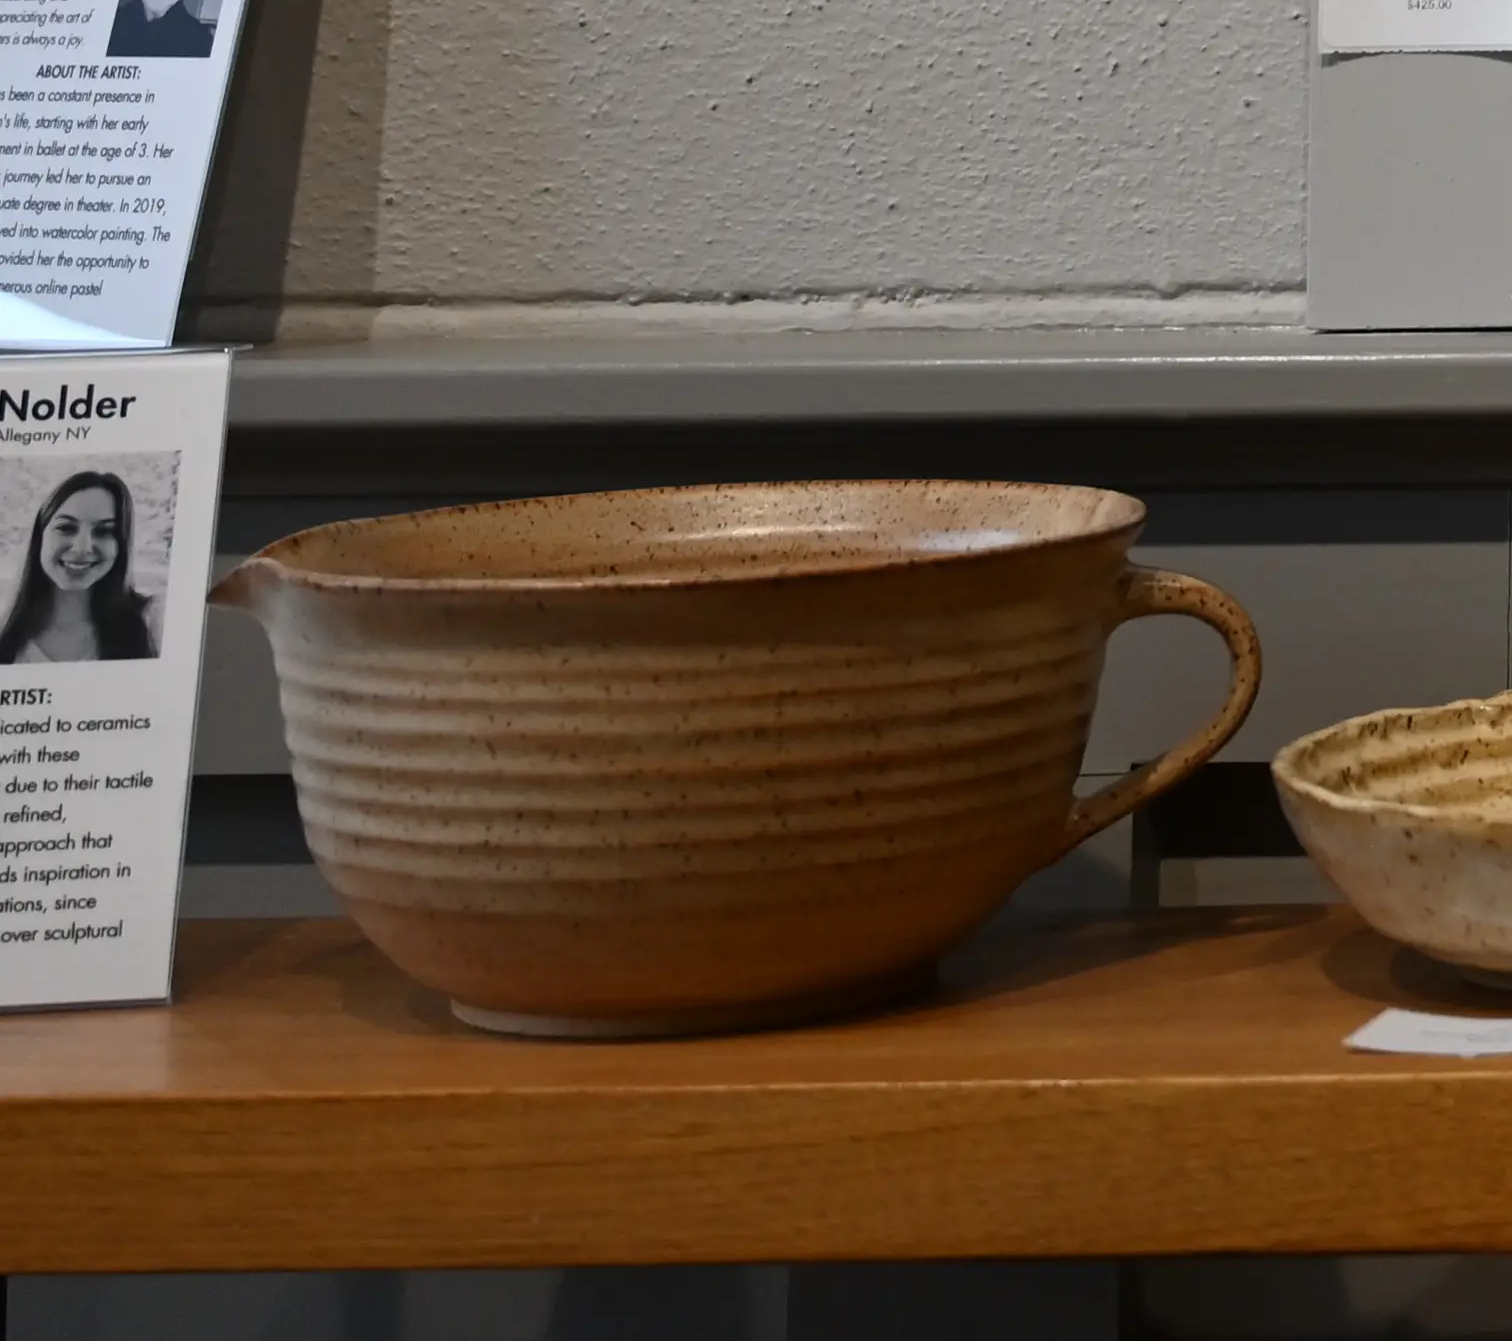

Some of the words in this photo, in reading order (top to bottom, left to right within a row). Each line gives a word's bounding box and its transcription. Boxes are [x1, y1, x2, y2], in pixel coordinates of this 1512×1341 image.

[35, 64, 76, 78] ABOUT
[78, 65, 99, 79] THE
[100, 65, 141, 79] ARTIST:
[0, 383, 136, 423] Nolder
[65, 426, 91, 440] NY
[56, 719, 72, 732] to
[76, 714, 151, 731] ceramics
[37, 745, 80, 762] these
[4, 776, 37, 793] due
[42, 778, 58, 792] to
[63, 773, 100, 791] their
[105, 770, 153, 789] tactile
[3, 803, 66, 823] refined,
